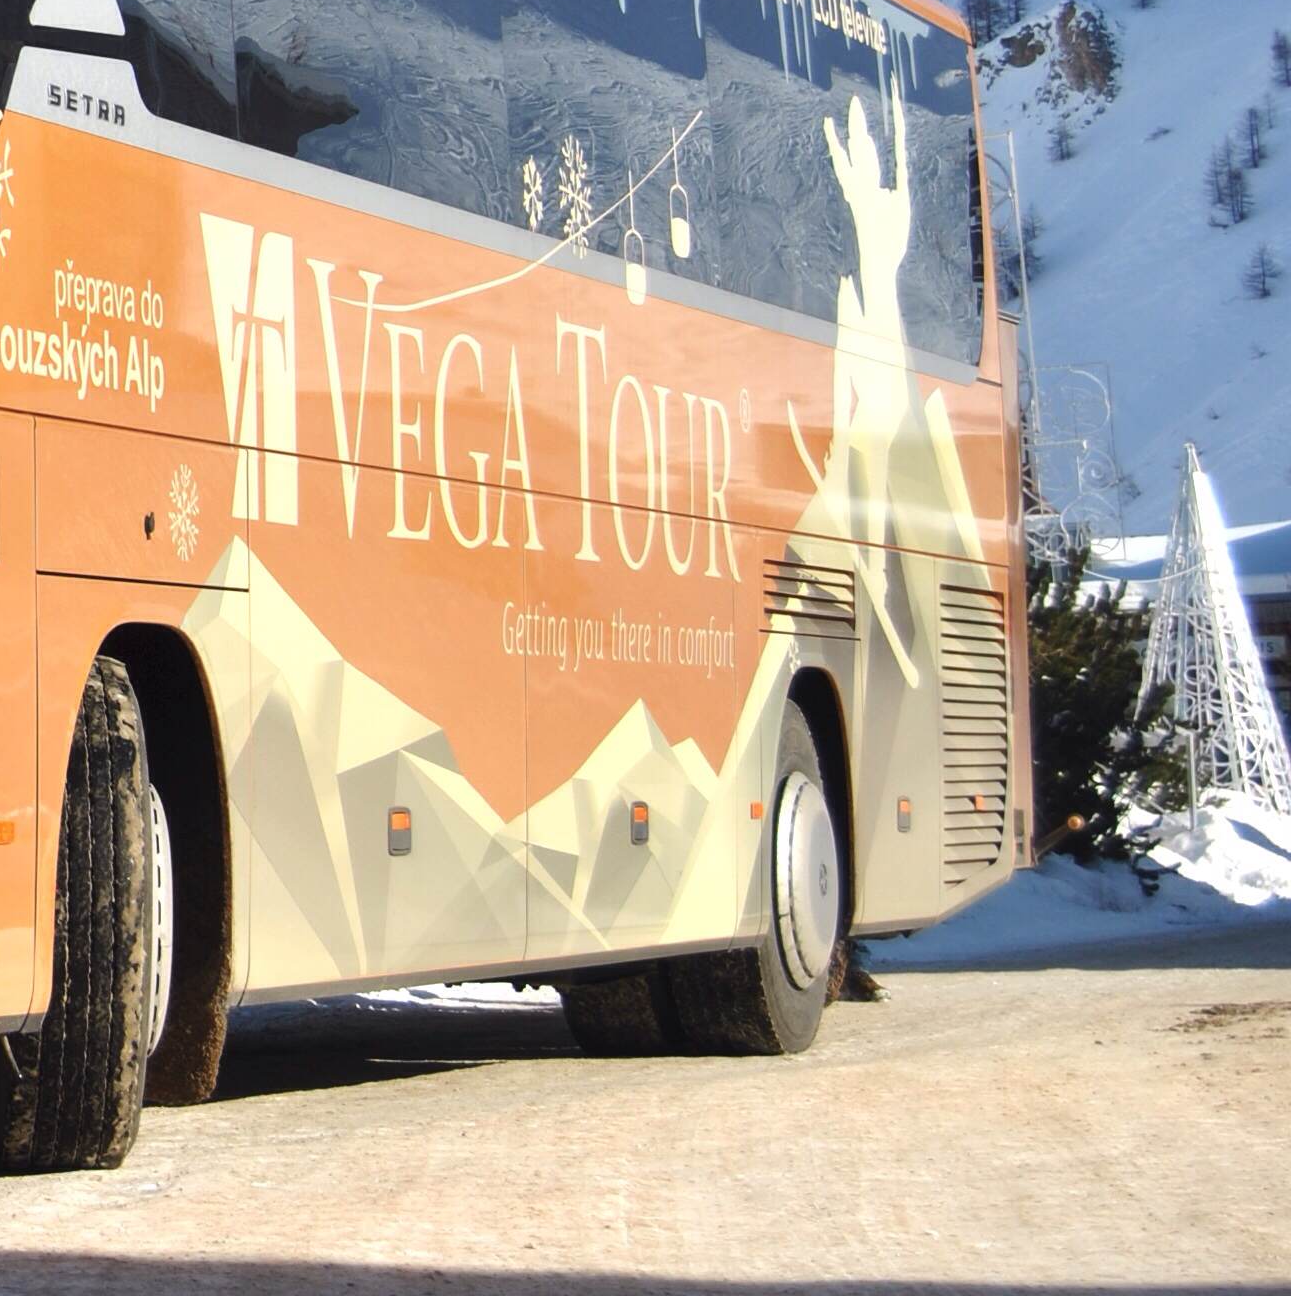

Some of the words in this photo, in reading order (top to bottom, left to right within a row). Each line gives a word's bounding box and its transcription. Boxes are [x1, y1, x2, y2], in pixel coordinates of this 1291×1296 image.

[46, 83, 127, 127] SETRA
[54, 258, 135, 325] přeprava
[140, 280, 164, 329] do
[125, 335, 165, 413] Alp
[305, 257, 545, 551] VEGA
[502, 601, 568, 672] Getting
[574, 615, 604, 672] you
[611, 608, 652, 663] there
[657, 612, 672, 664] in
[677, 615, 735, 680] comfort
